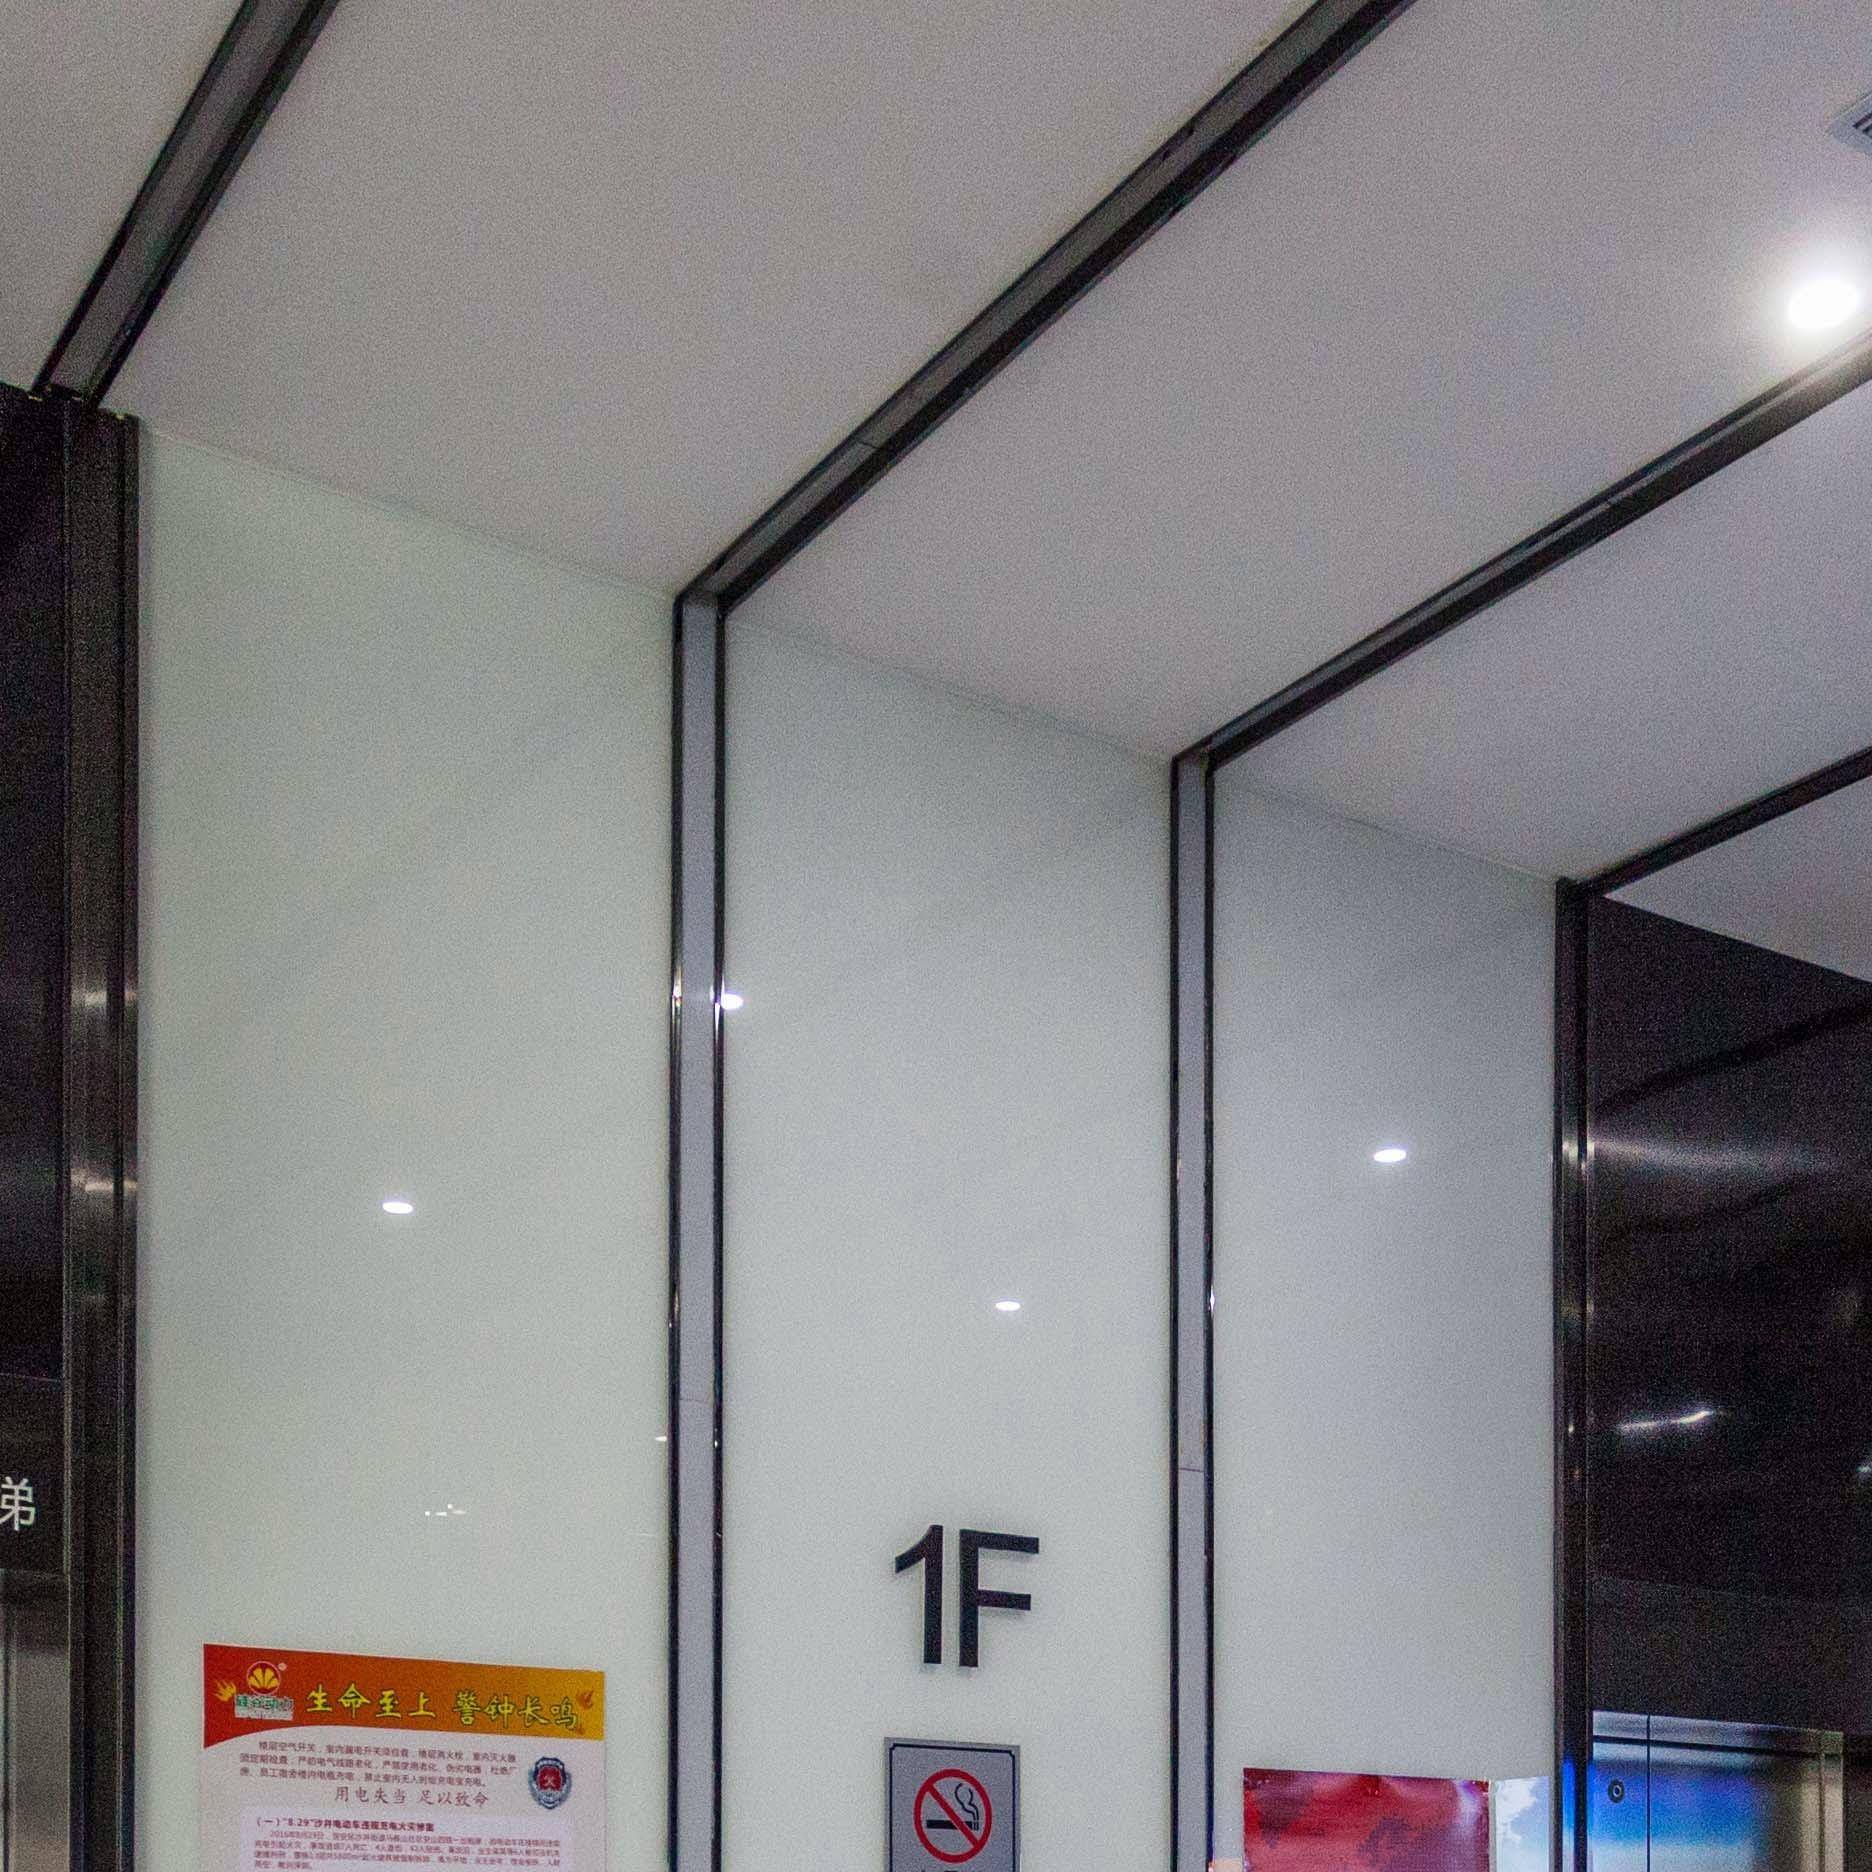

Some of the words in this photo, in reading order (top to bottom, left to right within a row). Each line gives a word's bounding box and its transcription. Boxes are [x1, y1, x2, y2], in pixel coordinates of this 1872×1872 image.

[895, 1524, 1040, 1667] 1F
[306, 1683, 436, 1719] 生命至上
[452, 1688, 579, 1729] 警钟长鸣
[334, 1785, 407, 1805] 用电失当
[418, 1787, 489, 1807] 足以致命
